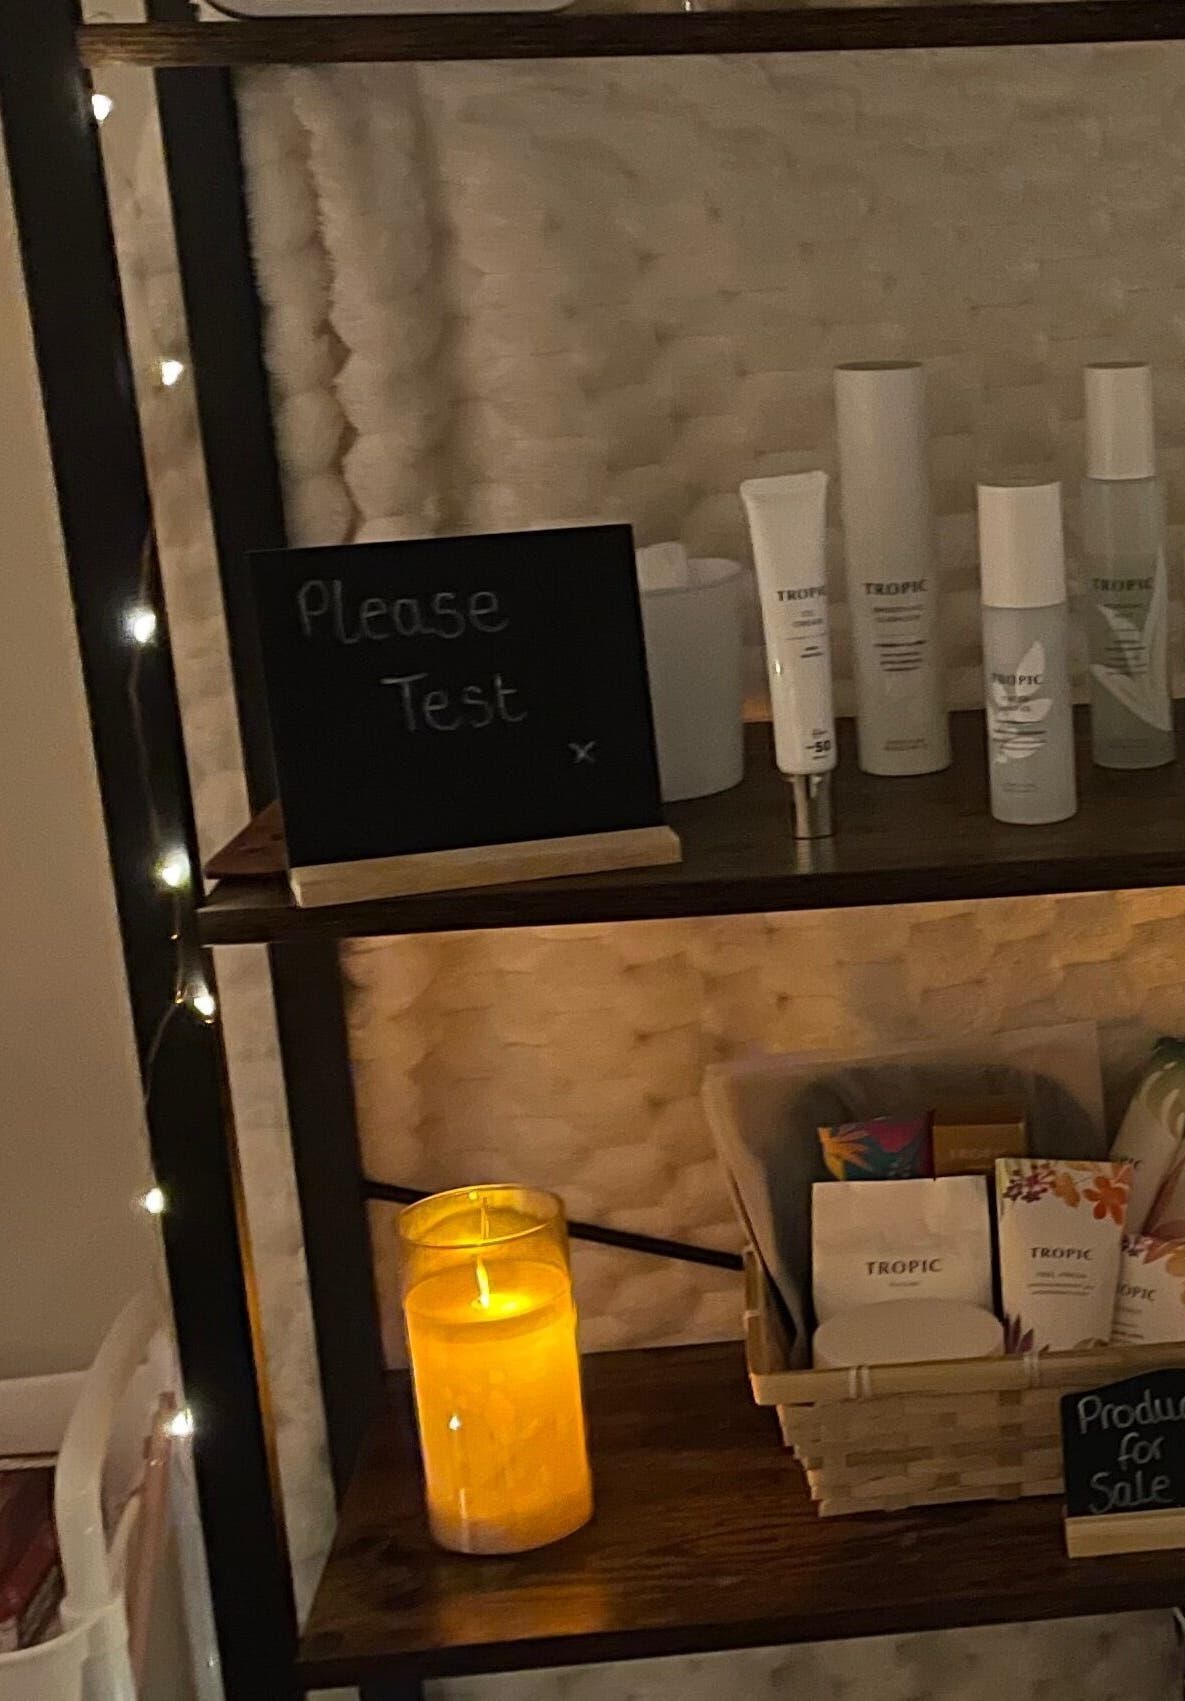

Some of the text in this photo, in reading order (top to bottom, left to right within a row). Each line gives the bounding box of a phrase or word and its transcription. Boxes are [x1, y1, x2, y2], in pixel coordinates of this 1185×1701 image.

[864, 579, 928, 595] TROPIC
[1092, 577, 1153, 591] TROPIC
[298, 579, 510, 644] Please
[380, 672, 528, 732] Test
[865, 1258, 944, 1276] TROPIC
[1029, 1246, 1094, 1262] TROPIC
[1117, 1432, 1164, 1470] for
[1089, 1471, 1175, 1514] Sale
